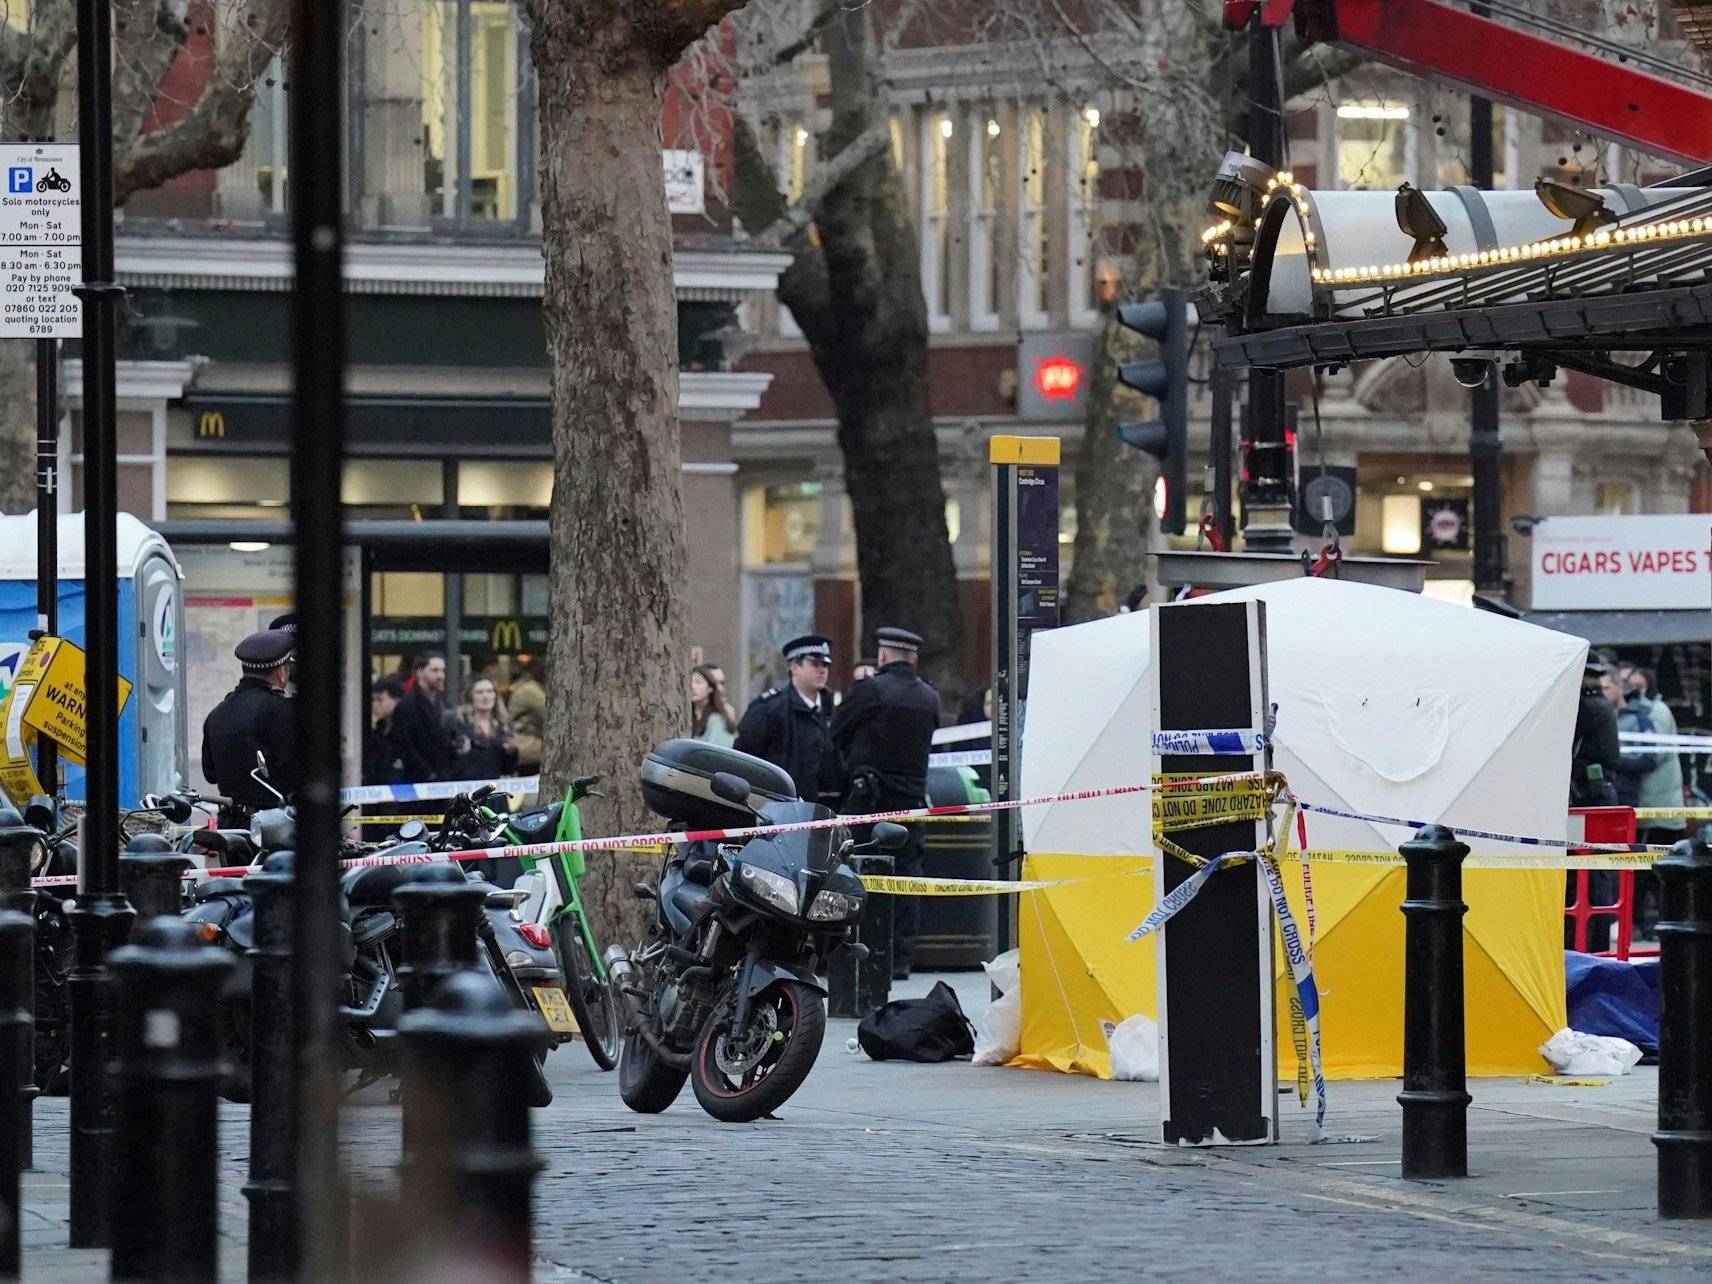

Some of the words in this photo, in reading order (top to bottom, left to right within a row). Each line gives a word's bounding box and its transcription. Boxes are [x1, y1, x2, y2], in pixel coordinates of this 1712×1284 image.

[14, 169, 30, 191] P
[2, 198, 22, 206] Solo
[25, 198, 80, 207] motorcycles
[31, 208, 50, 217] only
[1, 233, 22, 241] 7.00
[44, 233, 65, 241] 7.00
[67, 234, 80, 242] pm
[20, 250, 39, 258] Mon
[46, 250, 62, 258] Sat
[1, 261, 22, 270] 8.30
[44, 261, 66, 270] 6.30
[11, 274, 28, 283] Pay
[30, 274, 41, 283] by
[44, 274, 71, 283] phone
[6, 284, 24, 292] 020
[28, 284, 48, 292] 7125
[4, 305, 35, 313] 07860
[38, 305, 56, 313] 022
[60, 305, 78, 313] 205
[5, 315, 38, 324] quoting
[41, 315, 77, 323] location
[29, 325, 53, 333] 6789
[1542, 552, 1621, 574] CIGARS
[1629, 550, 1697, 573] VAPES
[64, 682, 73, 691] at
[46, 684, 86, 719] WARN
[56, 712, 86, 738] Parking
[43, 721, 86, 752] suspension
[1163, 800, 1180, 817] NOT
[1183, 800, 1196, 816] DO
[1202, 798, 1226, 814] ZONE
[503, 845, 546, 857] POLICE
[550, 844, 578, 854] LINE
[582, 842, 599, 851] DO
[602, 840, 626, 850] NOT
[631, 836, 673, 846] CROSS
[896, 879, 908, 892] NOT
[908, 879, 928, 892] CROSS
[1269, 879, 1283, 895] DO
[1276, 896, 1292, 921] NOT
[1283, 924, 1306, 965] CROSS
